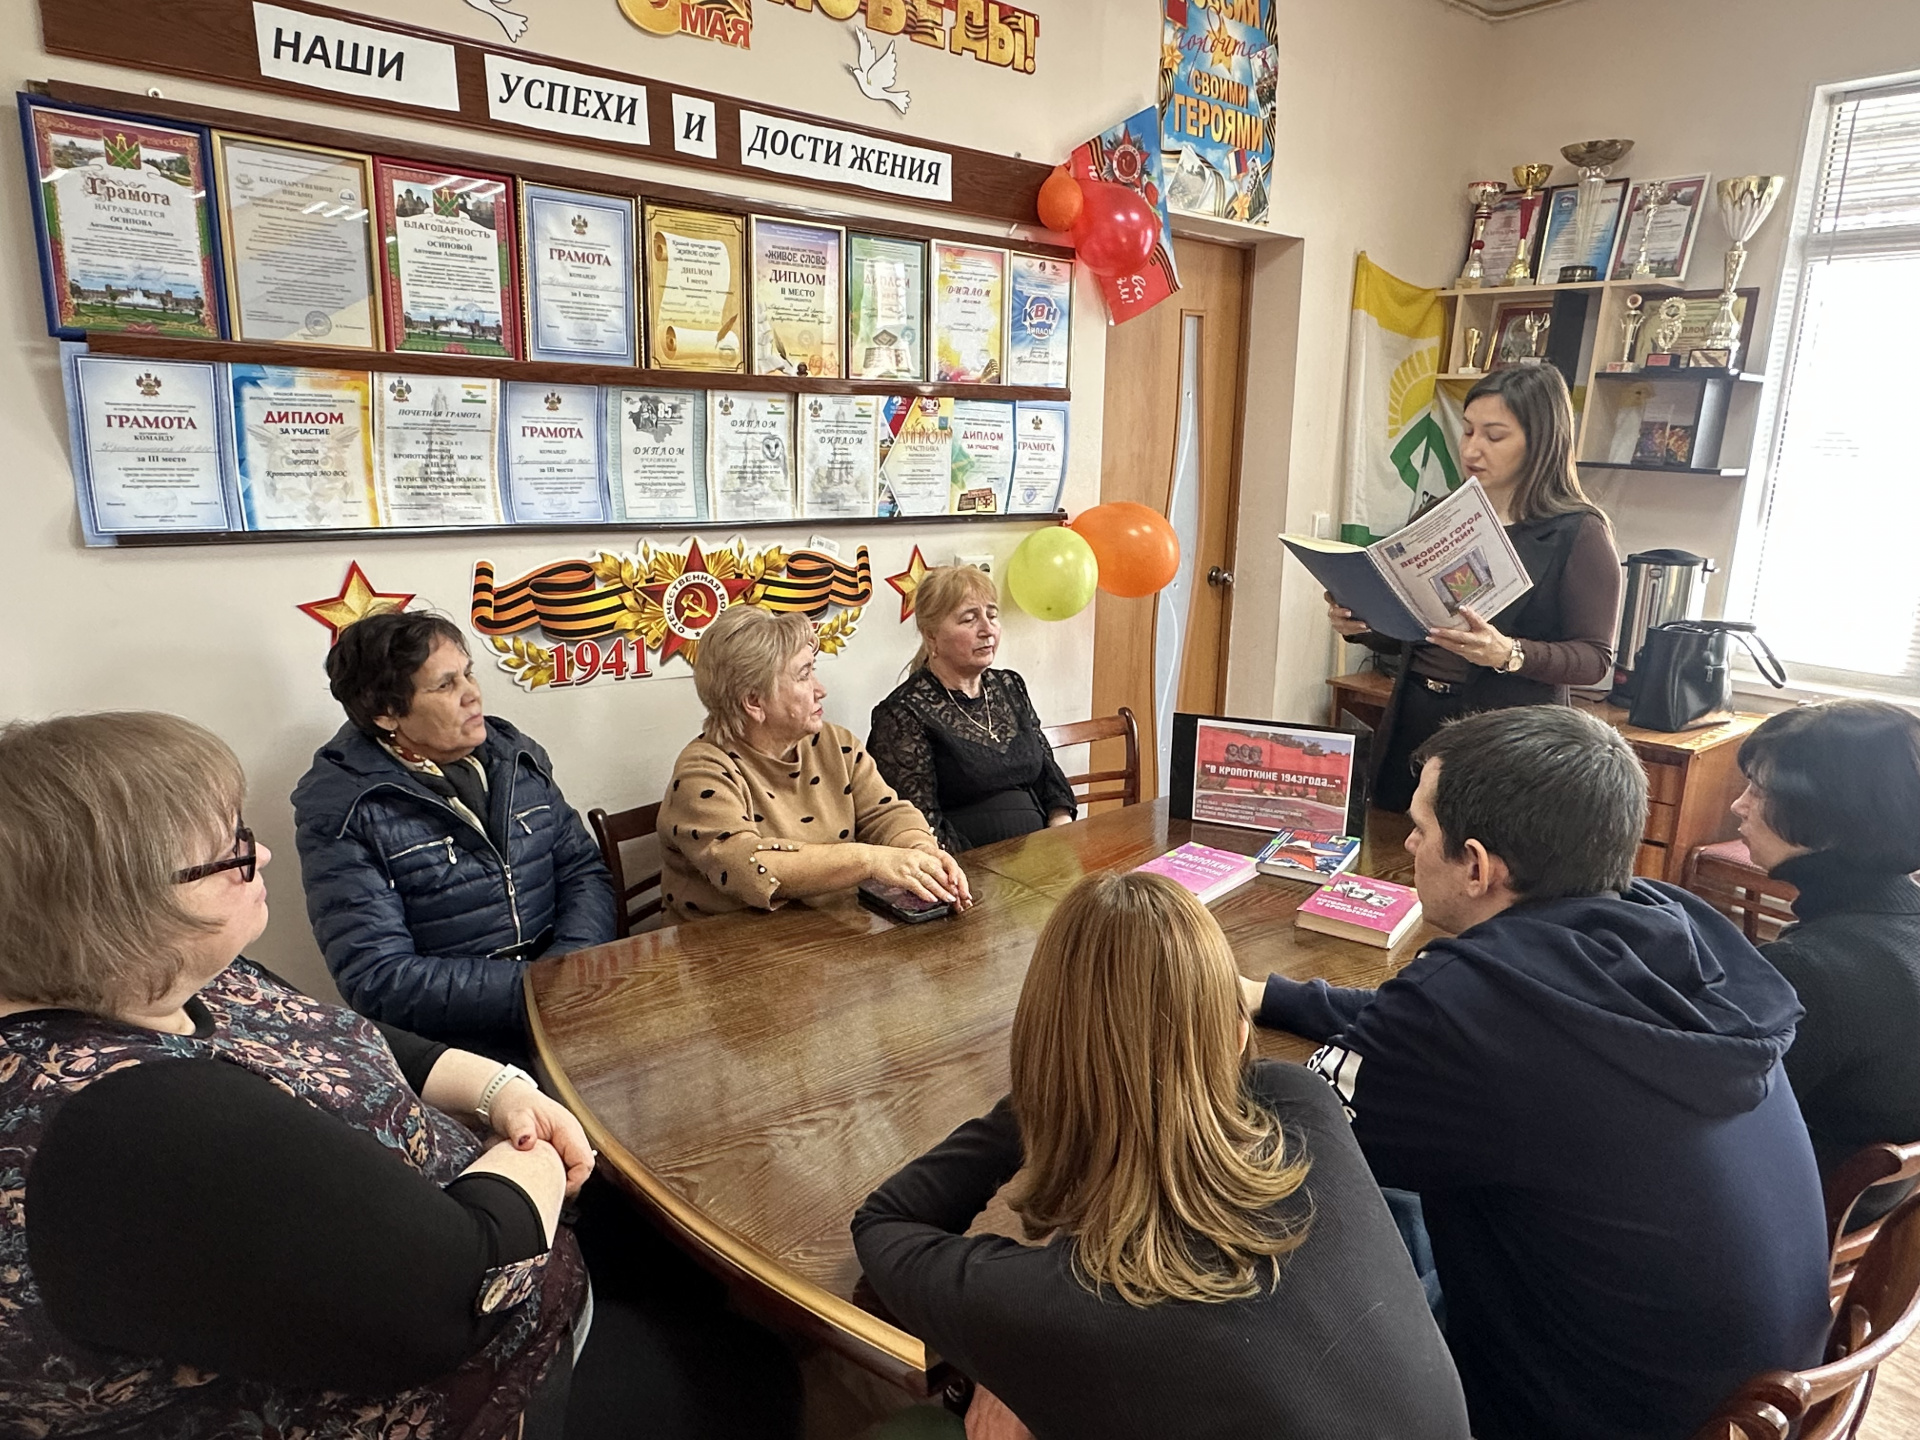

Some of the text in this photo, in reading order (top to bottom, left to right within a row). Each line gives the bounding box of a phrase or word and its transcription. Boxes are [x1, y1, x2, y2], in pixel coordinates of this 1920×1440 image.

[681, 3, 750, 48] МАЯ
[766, 0, 1036, 75] БЕДЫ!
[1176, 5, 1272, 86] гордится
[273, 28, 405, 82] НАШИ
[499, 73, 638, 127] УСПЕХИ
[682, 111, 706, 144] И
[1193, 69, 1249, 109] СВОИМИ
[1174, 93, 1265, 154] ГЕРОЯМИ
[86, 176, 171, 206] Грамота
[259, 176, 334, 193] БЛАГОДАРСТВЕННОЕ
[281, 188, 313, 199] ПИСЬМО
[94, 203, 166, 219] НАГРАЖДАЕТСЯ
[110, 215, 153, 227] ОСИПОВА
[403, 221, 491, 239] БЛАГОДАРНОСТЬ
[427, 240, 473, 251] ОСИПОВОЙ
[549, 248, 612, 267] ГРАМОТА
[769, 269, 826, 287] ДИПЛОМ
[788, 287, 815, 298] МЕСТО
[946, 286, 991, 298] ДИПЛОМ
[1023, 304, 1058, 323] КВН
[1026, 326, 1054, 336] ДИПЛОМ
[263, 411, 344, 425] ДИПЛОМ
[398, 408, 481, 419] ПОЧЕТНАЯ ГРАМОТА
[658, 402, 673, 418] 85
[105, 414, 197, 430] ГРАМОТА
[730, 419, 777, 428] ДИПЛОМ
[521, 426, 583, 438] ГРАМОТА
[962, 430, 1004, 441] ДИПЛОМ
[820, 437, 863, 445] ДИПЛОМ
[1018, 441, 1056, 451] ГРАМОТА
[633, 446, 685, 456] ДИПЛОМ
[1400, 536, 1448, 568] ВЕКОВОЙ
[1449, 511, 1482, 538] ГОРОД
[1416, 526, 1475, 569] КРОПОТКИН
[666, 574, 721, 634] ОТЕЧЕСТВЕННАЯ
[548, 635, 653, 687] 1941
[1219, 765, 1278, 781] КРОПОТКИНЕ
[1177, 852, 1234, 872] КРОПОТКИН
[1325, 902, 1378, 919] КРОПОТКИНА
[1354, 906, 1386, 917] КУБАНИ
